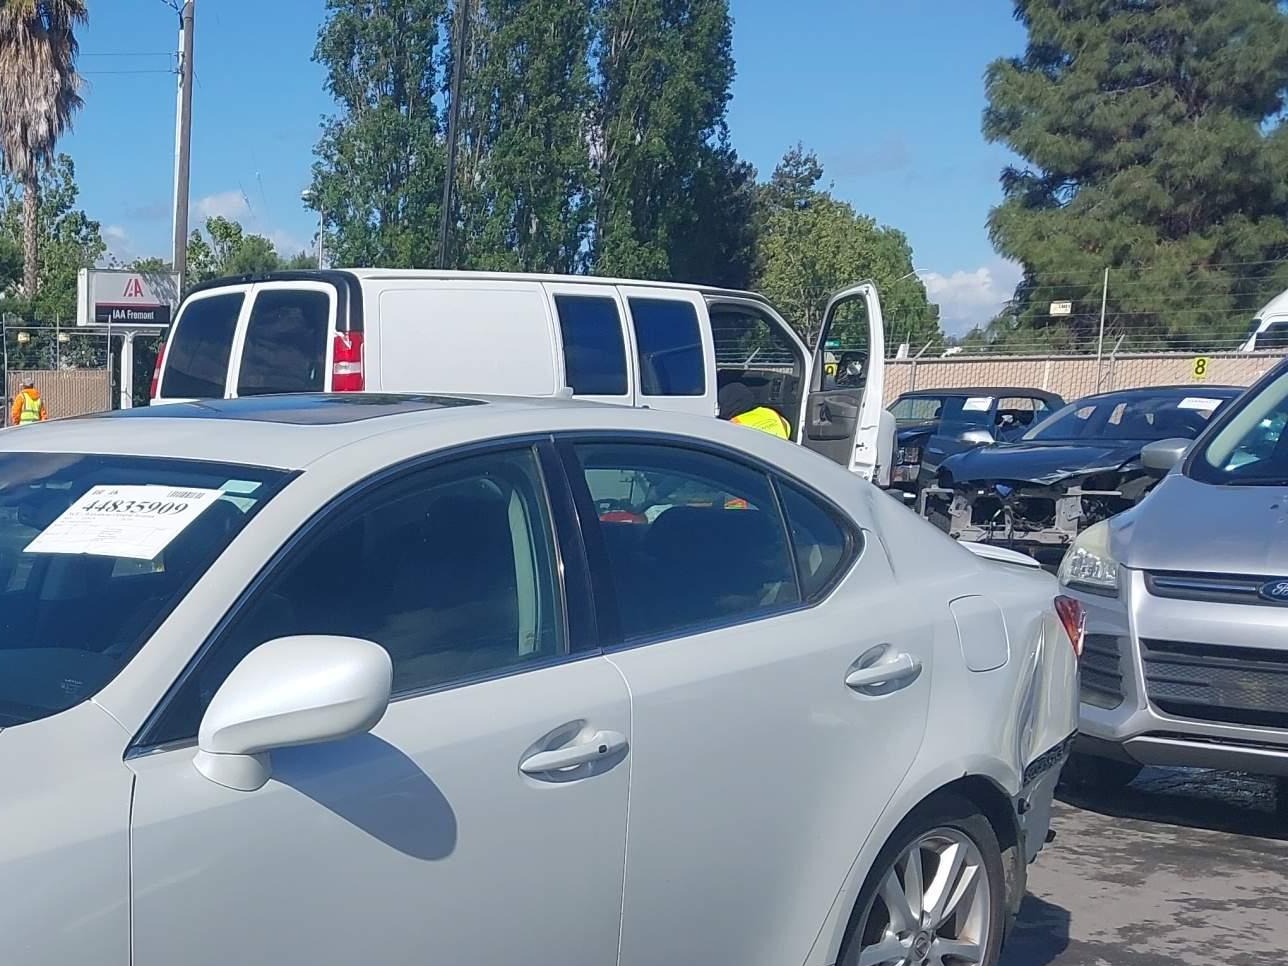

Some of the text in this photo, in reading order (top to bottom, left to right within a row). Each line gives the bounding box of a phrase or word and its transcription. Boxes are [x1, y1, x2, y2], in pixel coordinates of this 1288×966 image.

[112, 309, 155, 320] IAA Fremont
[1194, 358, 1206, 375] 8
[81, 499, 189, 515] 44835909
